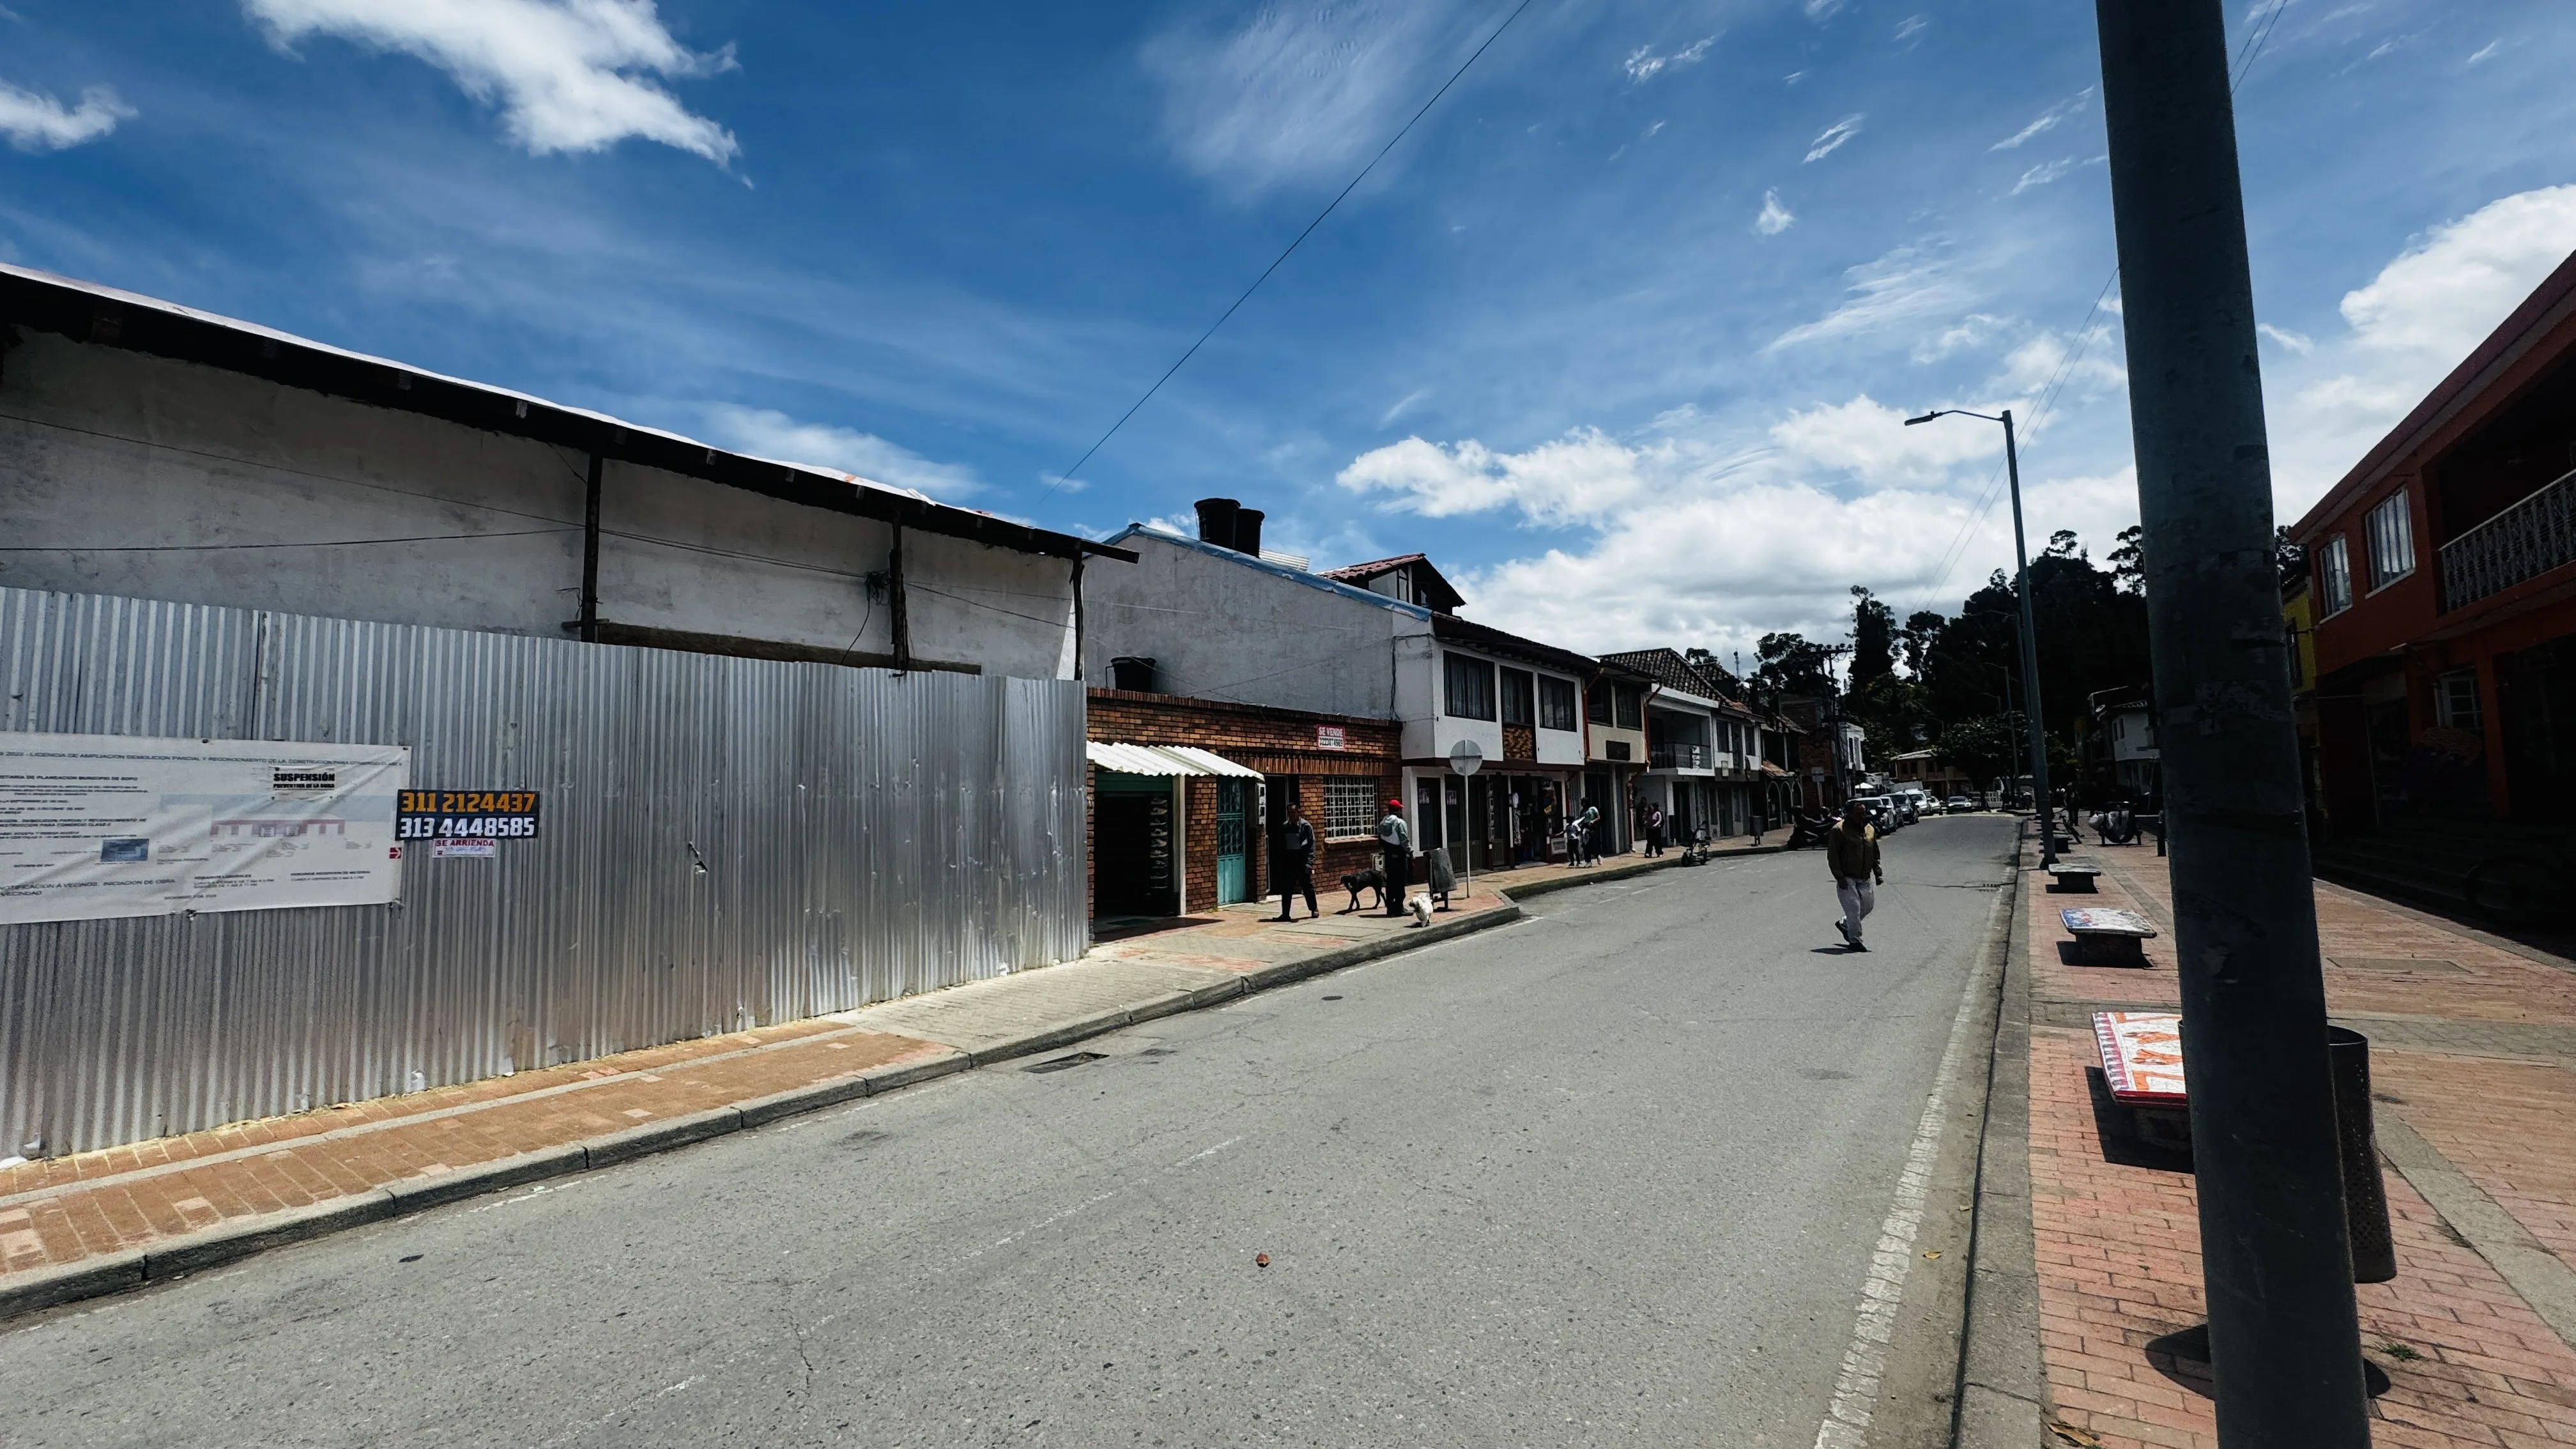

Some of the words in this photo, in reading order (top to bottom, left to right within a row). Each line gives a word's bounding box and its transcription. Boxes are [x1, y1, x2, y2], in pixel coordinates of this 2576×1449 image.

[1319, 727, 1326, 735] SE
[1326, 728, 1343, 737] VENDE
[273, 772, 335, 781] SUSPENSIÓN
[401, 792, 437, 812] 311
[442, 793, 535, 812] 2124437
[399, 817, 436, 838] 313
[438, 817, 535, 837] 4448585
